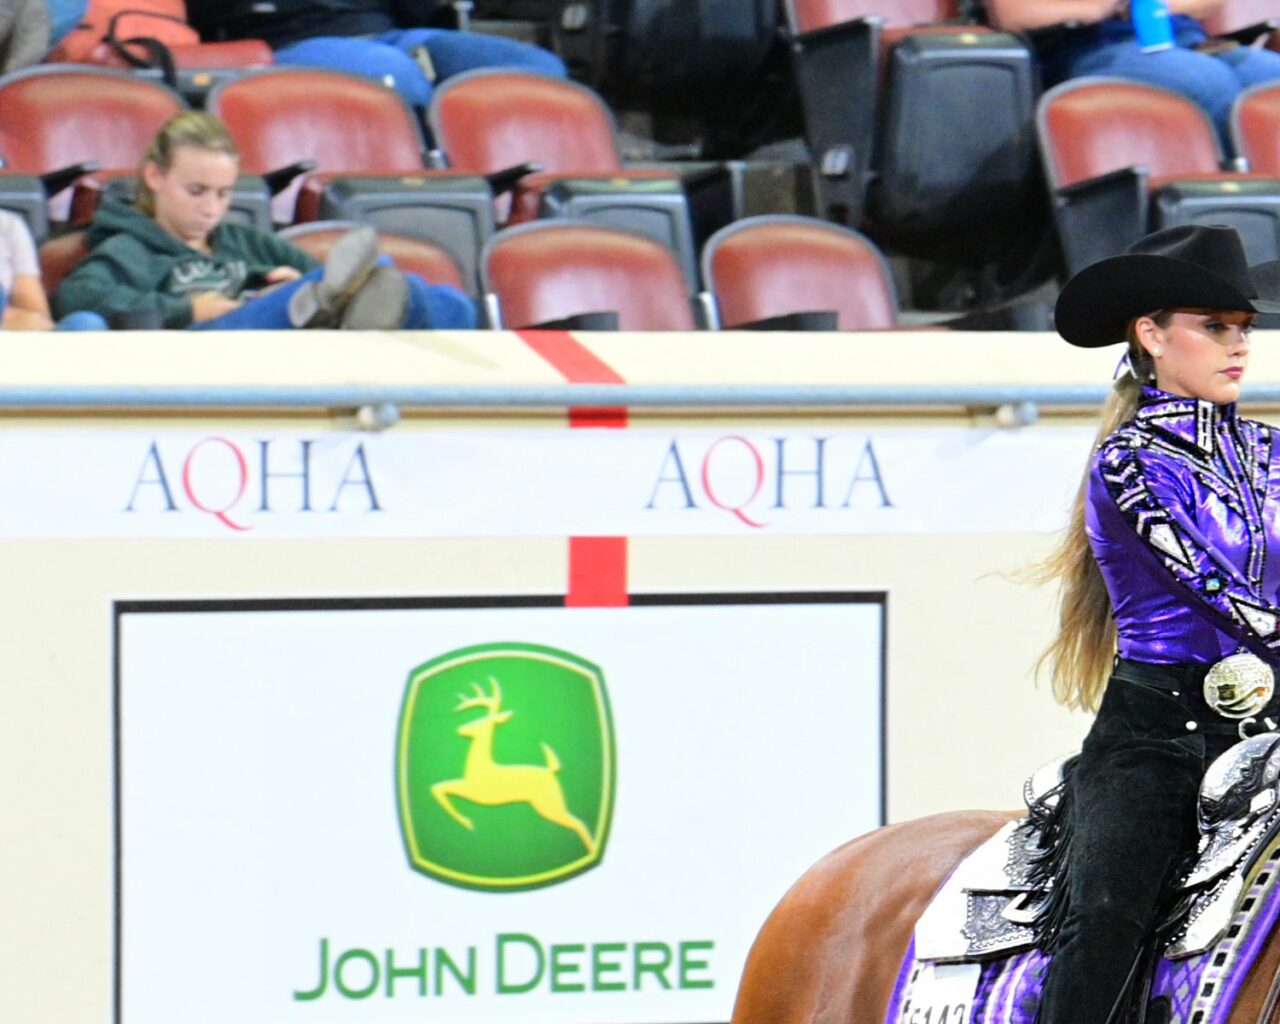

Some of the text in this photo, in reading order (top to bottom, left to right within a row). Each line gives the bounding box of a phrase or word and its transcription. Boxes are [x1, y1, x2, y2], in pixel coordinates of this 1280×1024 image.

[125, 438, 385, 531] AQHA
[645, 436, 893, 527] AQHA
[292, 932, 716, 1003] JOHN DEERE
